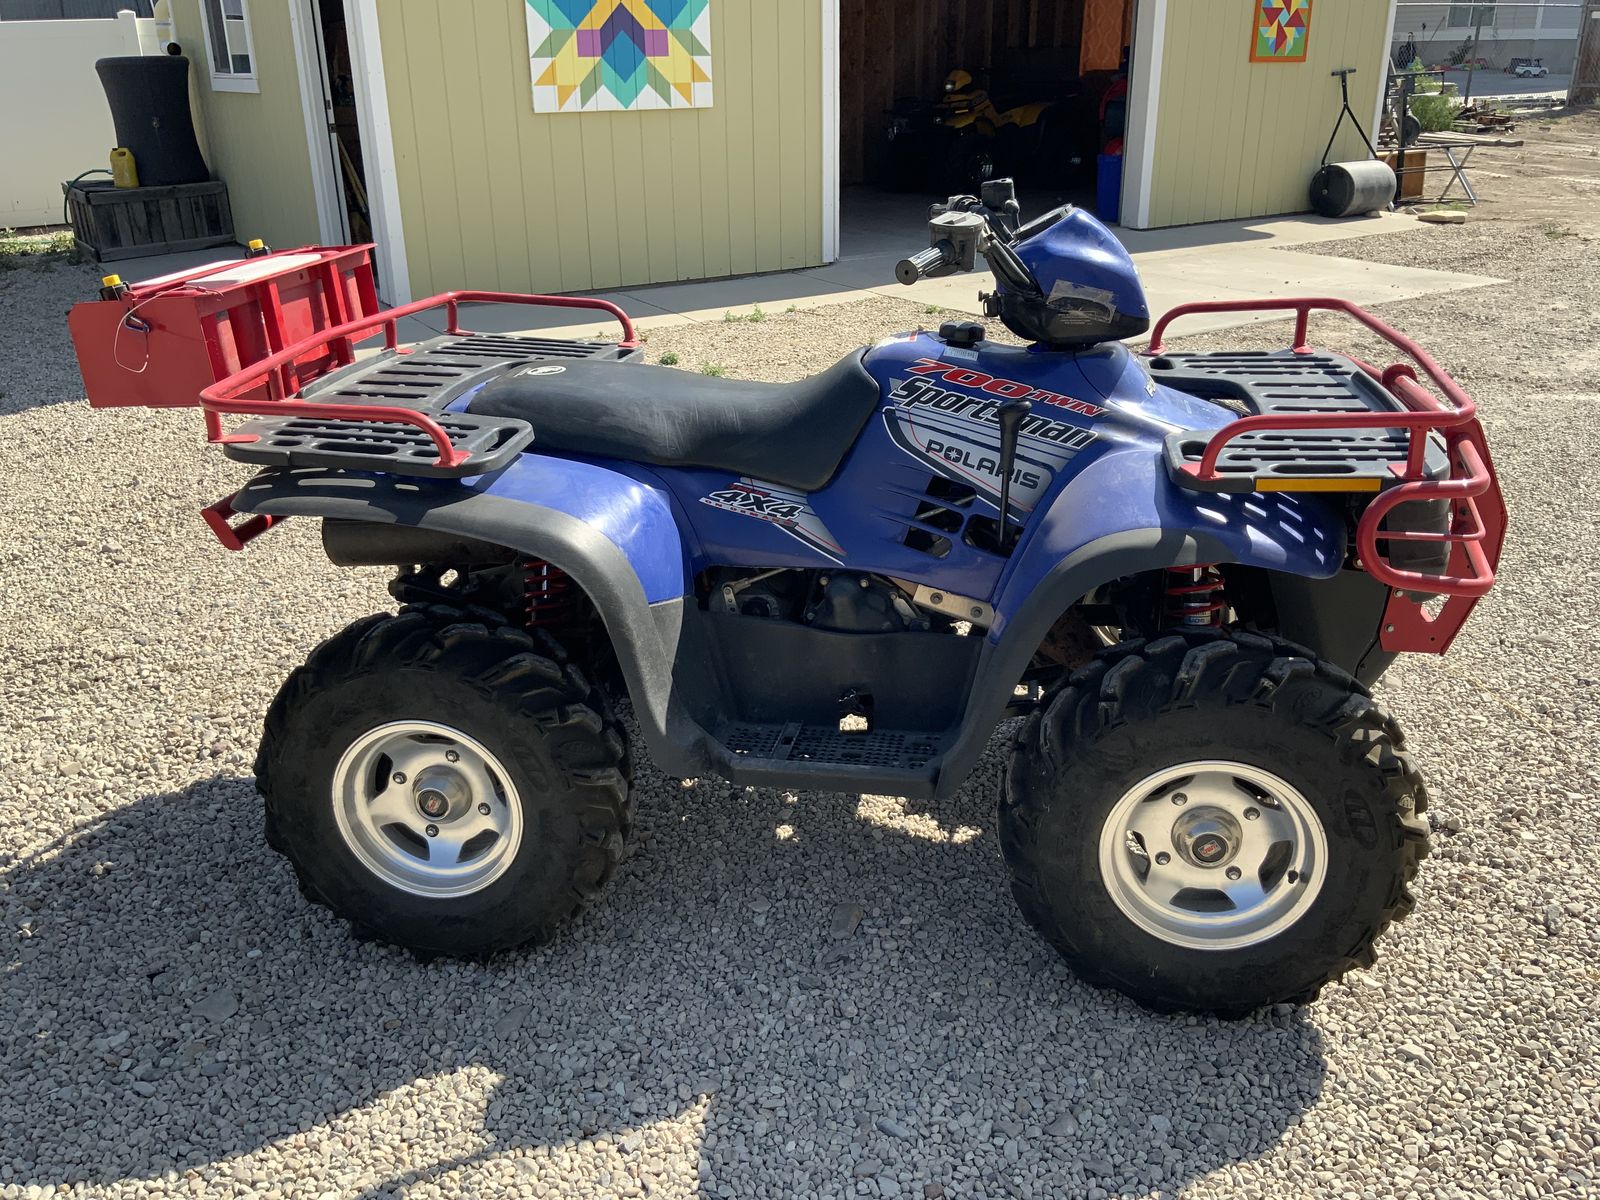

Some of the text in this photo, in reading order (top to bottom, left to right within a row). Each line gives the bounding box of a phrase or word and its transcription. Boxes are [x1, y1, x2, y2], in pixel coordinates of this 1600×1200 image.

[905, 358, 1104, 417] 700 TWIN
[709, 490, 804, 520] 4X4
